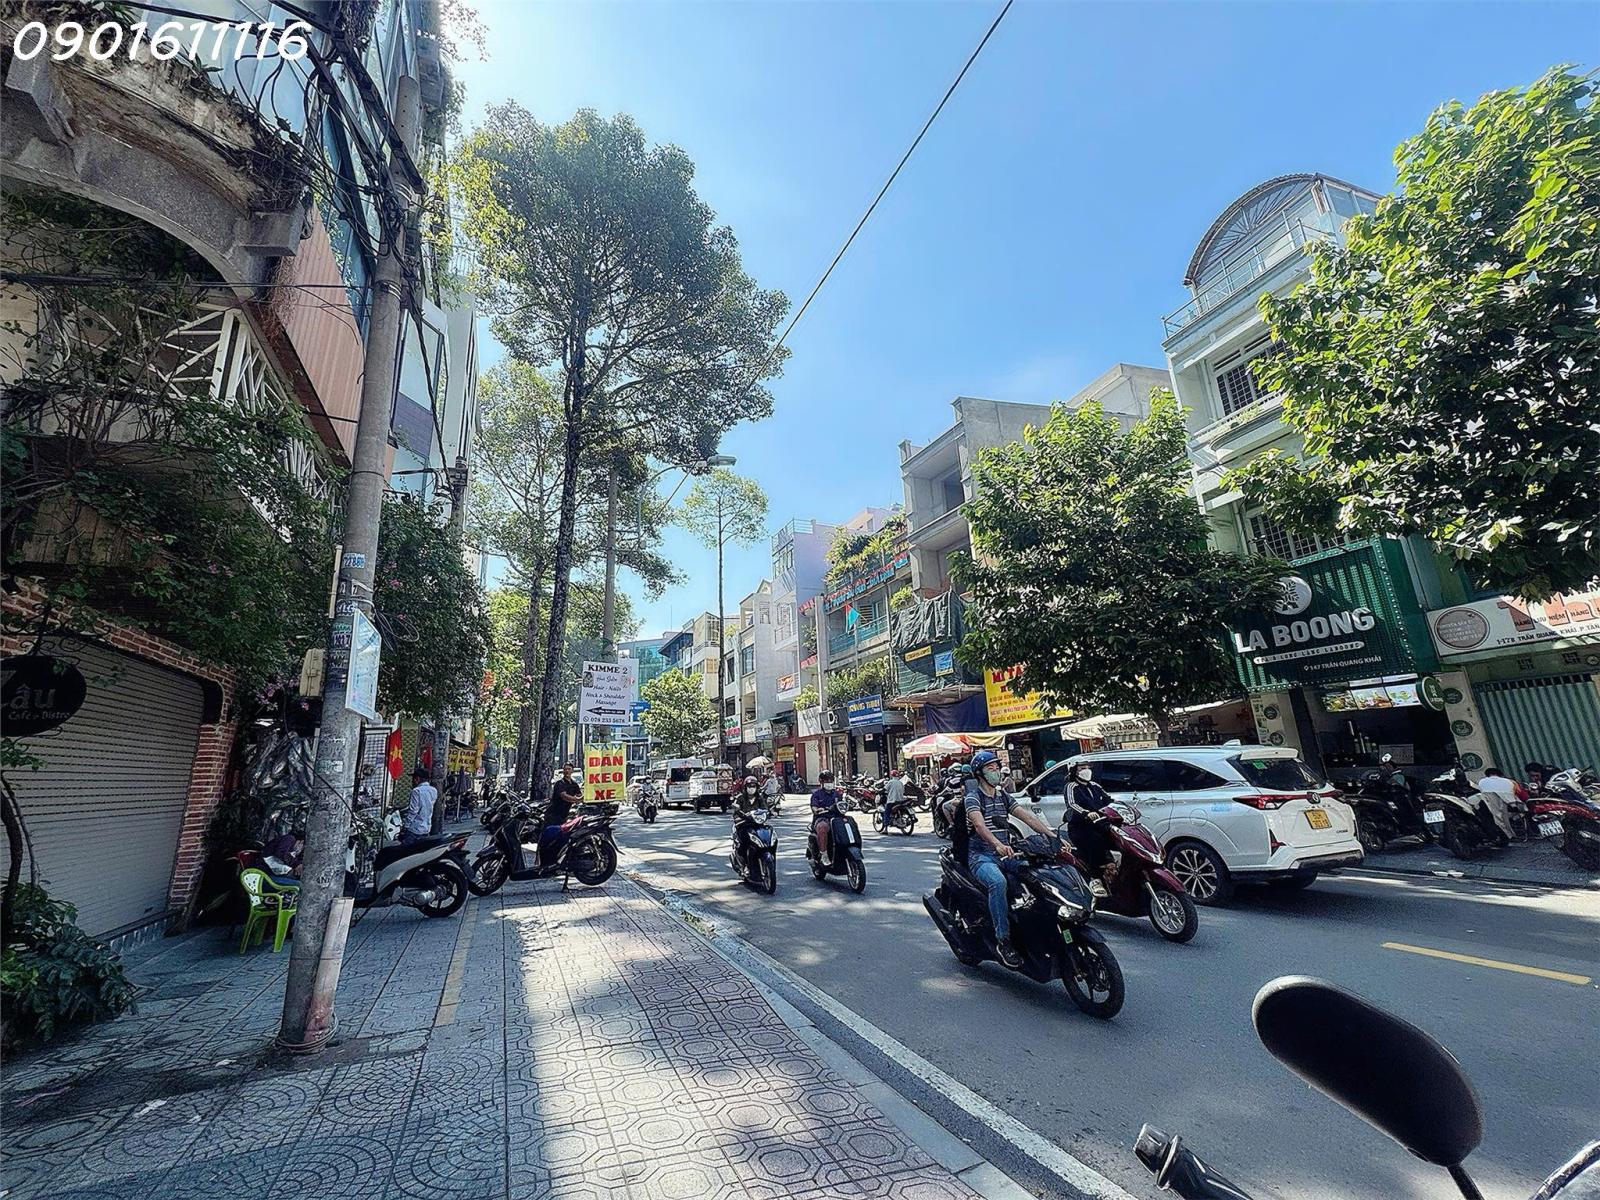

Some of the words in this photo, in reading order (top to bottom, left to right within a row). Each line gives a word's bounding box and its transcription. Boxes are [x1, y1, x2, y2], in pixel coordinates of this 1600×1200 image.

[1234, 629, 1268, 653] LA
[1272, 607, 1375, 647] BOONG
[1536, 630, 1557, 639] QUANG
[1339, 658, 1364, 667] QUANG
[588, 664, 620, 674] KIMME
[622, 667, 628, 675] 2
[588, 772, 624, 784] KEO
[594, 789, 616, 800] XE
